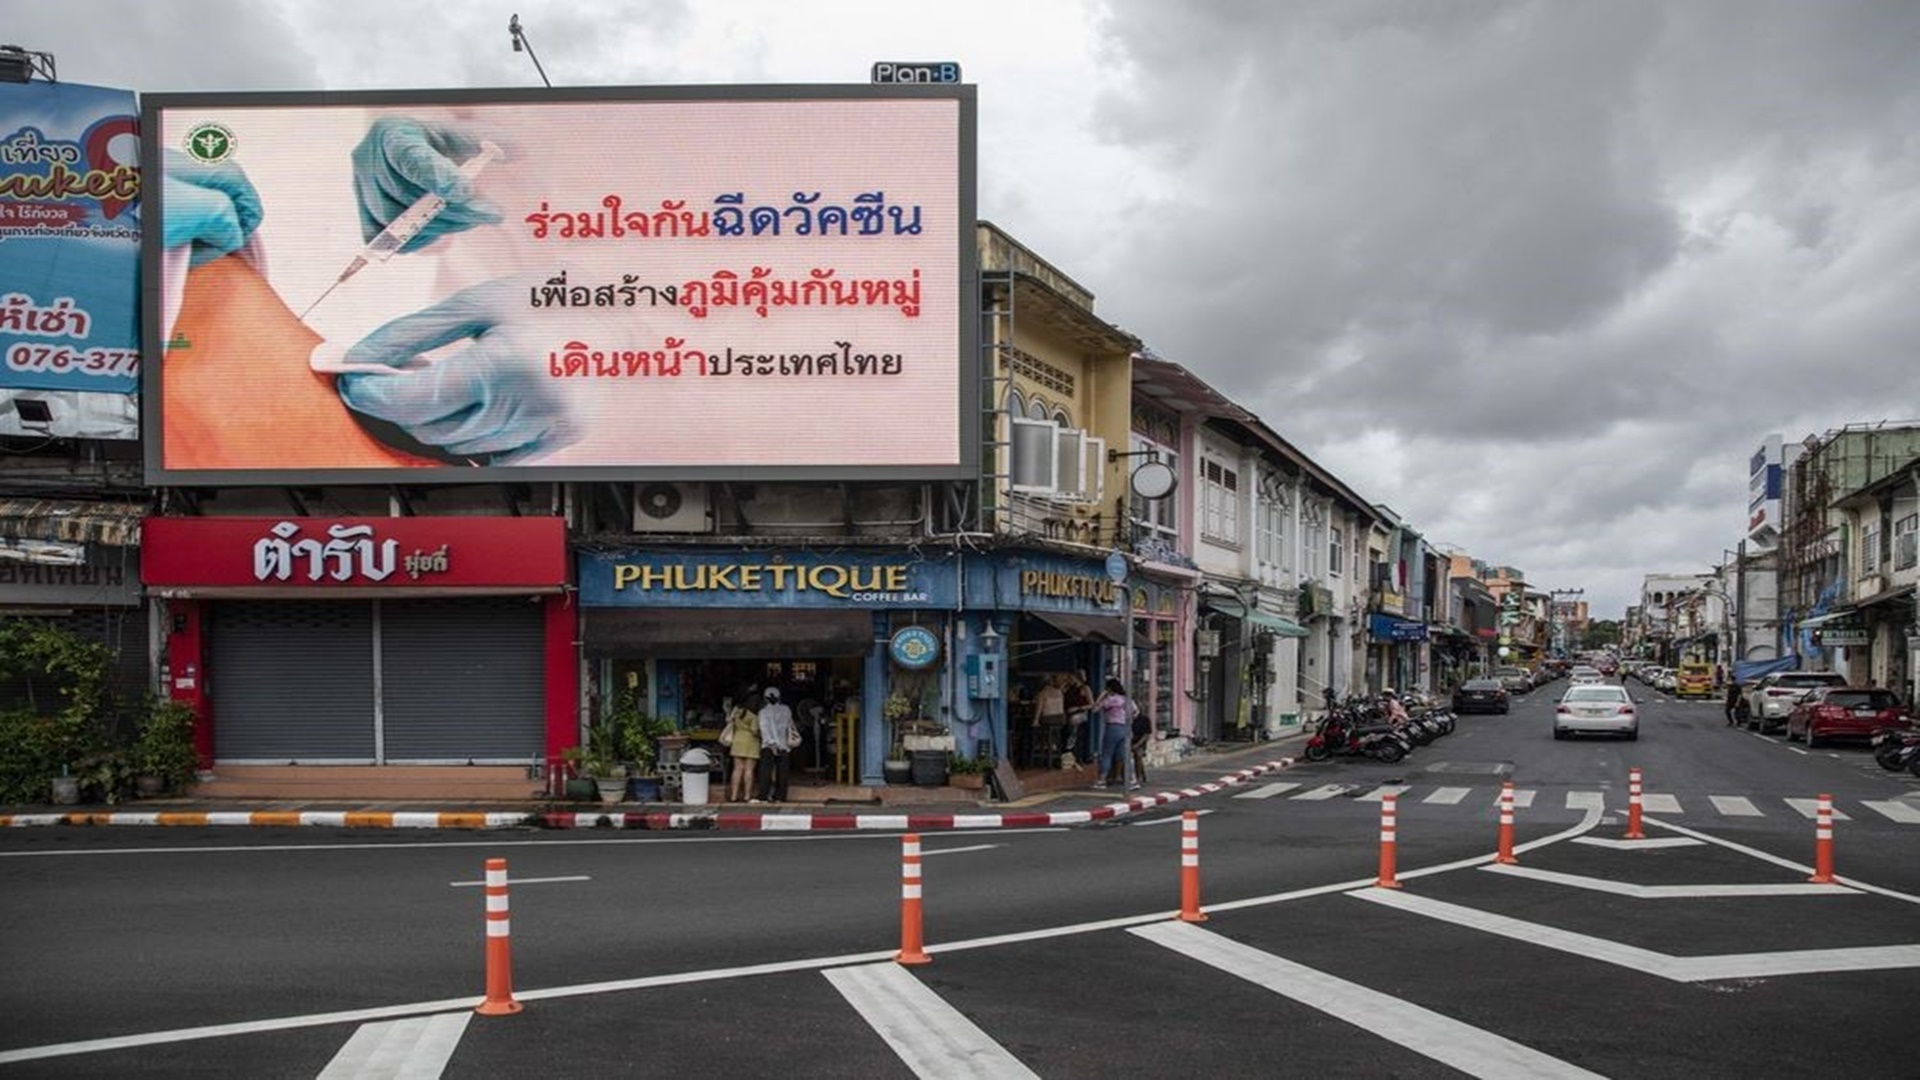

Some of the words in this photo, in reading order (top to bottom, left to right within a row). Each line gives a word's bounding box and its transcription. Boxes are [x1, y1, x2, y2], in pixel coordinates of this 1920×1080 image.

[4, 133, 79, 162] เที่ยว
[0, 165, 137, 198] uket
[254, 521, 399, 581] ตำรับ
[614, 564, 907, 597] PHUKETIQUE
[852, 592, 898, 602] COFFEE
[903, 592, 928, 601] BAR
